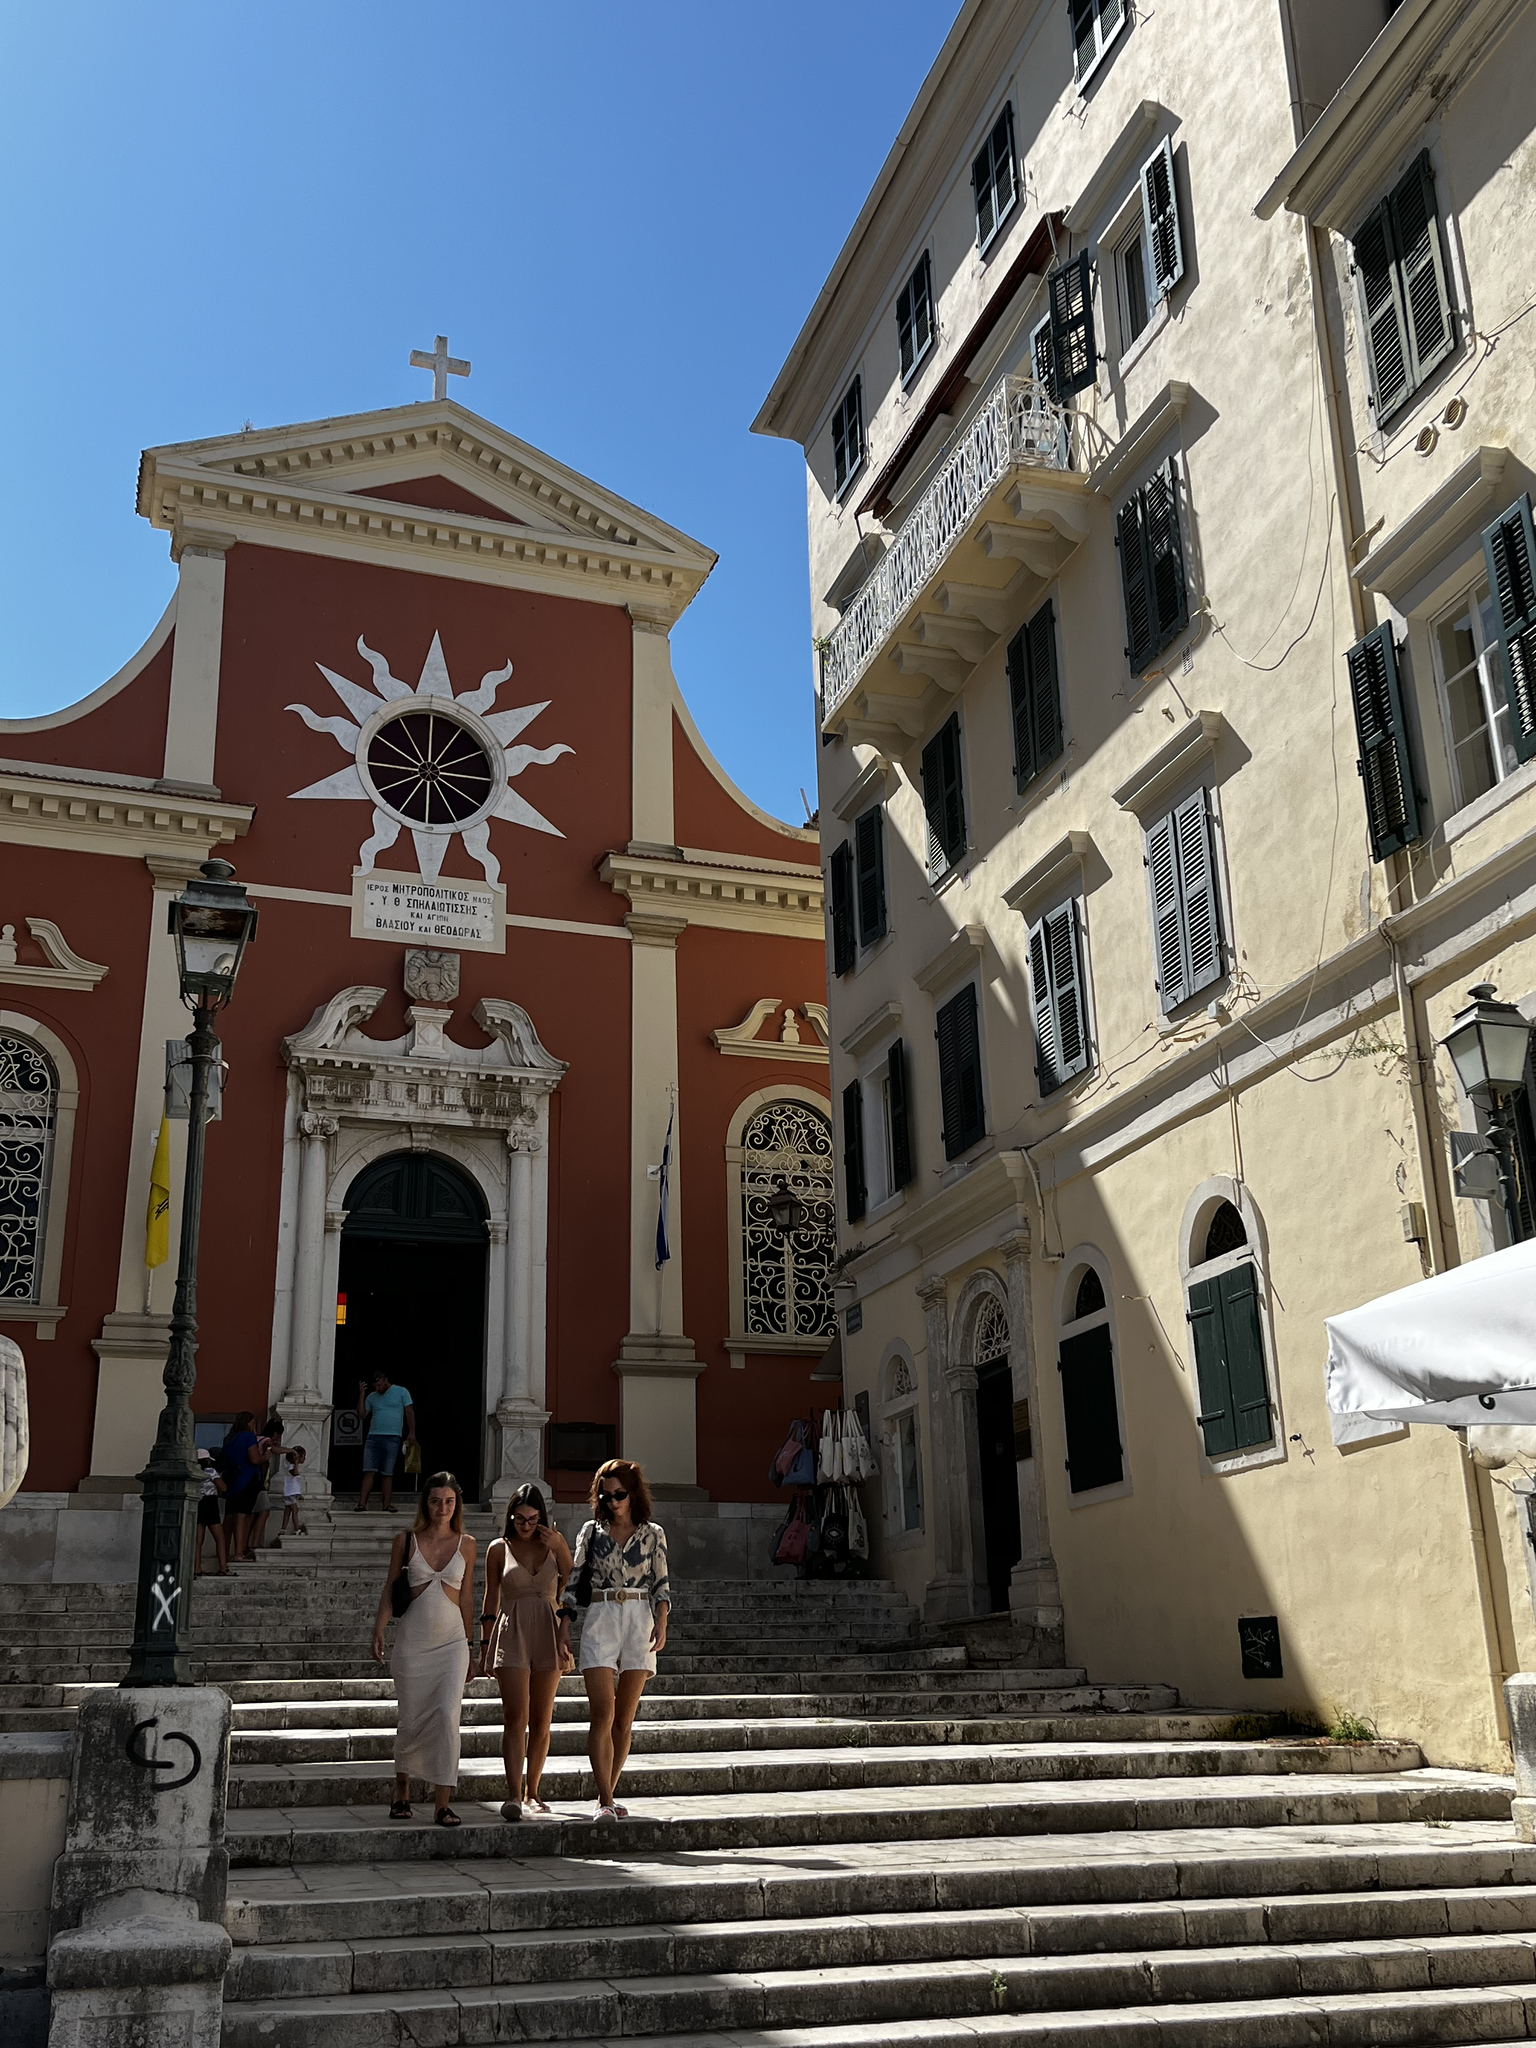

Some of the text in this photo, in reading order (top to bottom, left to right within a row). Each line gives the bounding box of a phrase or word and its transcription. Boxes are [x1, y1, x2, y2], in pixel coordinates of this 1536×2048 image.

[367, 884, 492, 904] ΙΕΡΟΣ ΜΗΤΡΟΠΟΛΙΤΙΚΟΣ ΝΑΟΣ
[406, 898, 478, 915] ΣΠΗΛΑΙΩΤΙΣΣΗΣ
[410, 911, 449, 922] ΚΑΙ ΑΓΙΩΝ
[376, 917, 482, 939] ΒΛΑΣΙΟΥ ΚΑΙ ΘΕΟΔΩΡΑΣ
